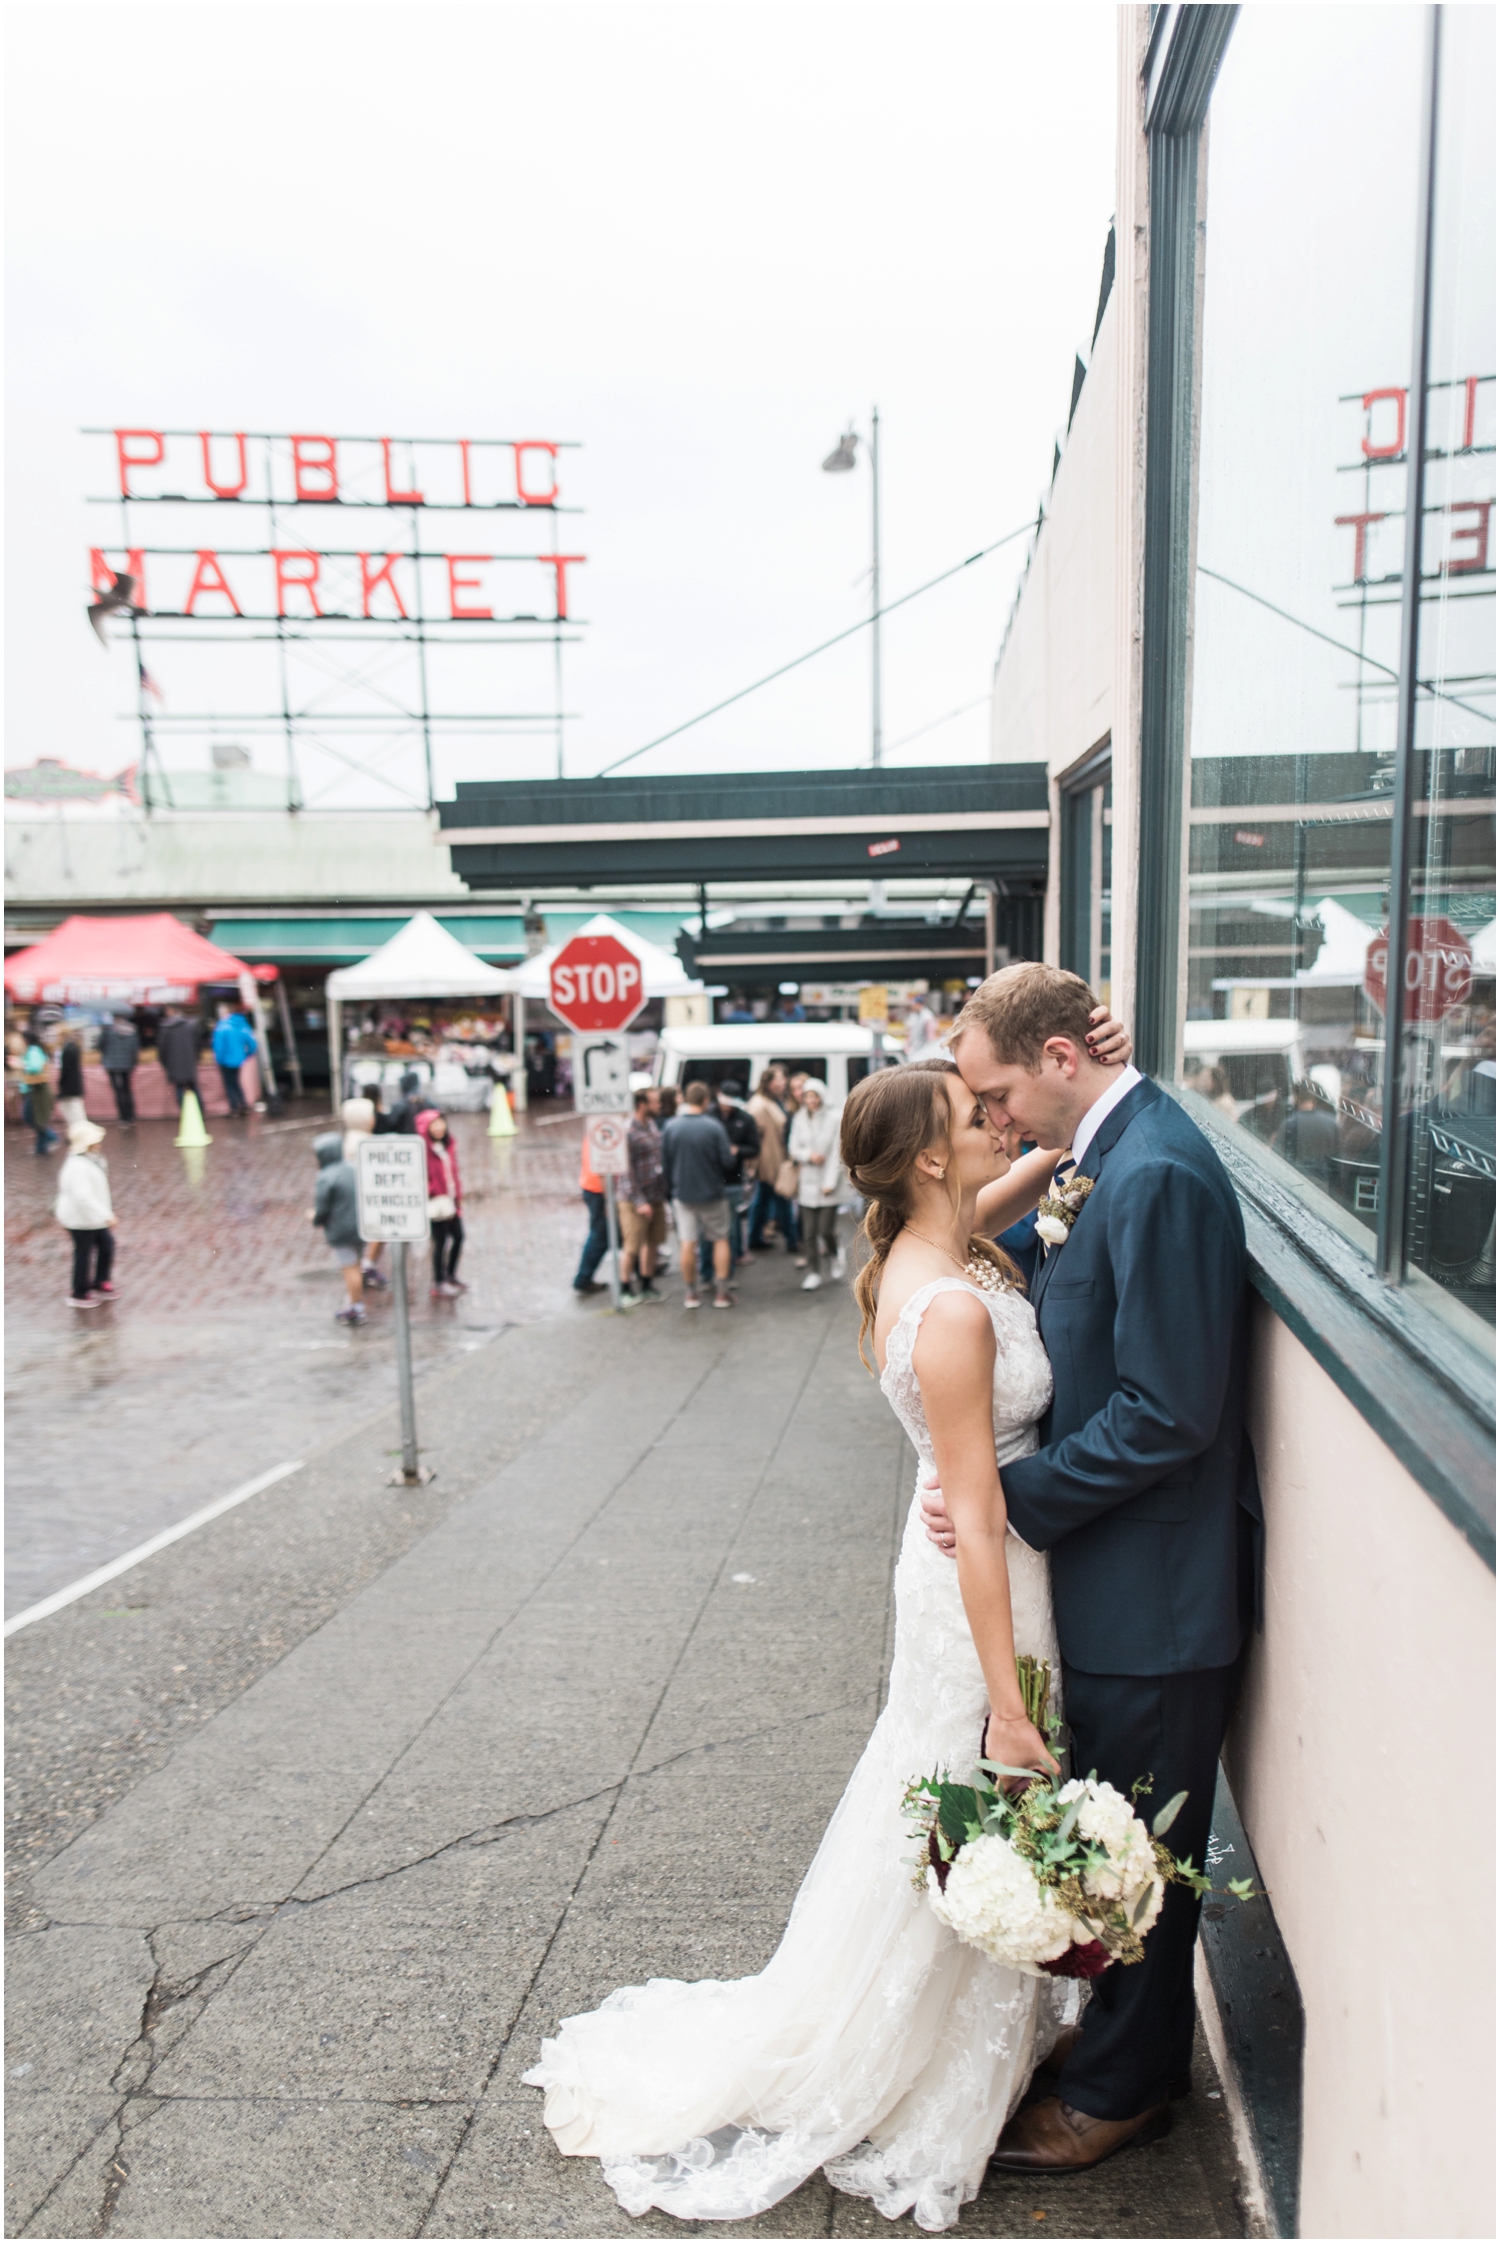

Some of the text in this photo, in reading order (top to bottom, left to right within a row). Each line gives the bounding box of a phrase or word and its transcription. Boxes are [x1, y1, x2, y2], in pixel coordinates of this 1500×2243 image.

[113, 429, 559, 504] PUBLIC
[89, 547, 586, 618] MARKET
[553, 962, 639, 1005] STOP
[583, 1091, 628, 1109] ONLY
[368, 1150, 413, 1166] POLICE
[365, 1194, 422, 1209] VEHICLES
[380, 1213, 408, 1227] ONLY
